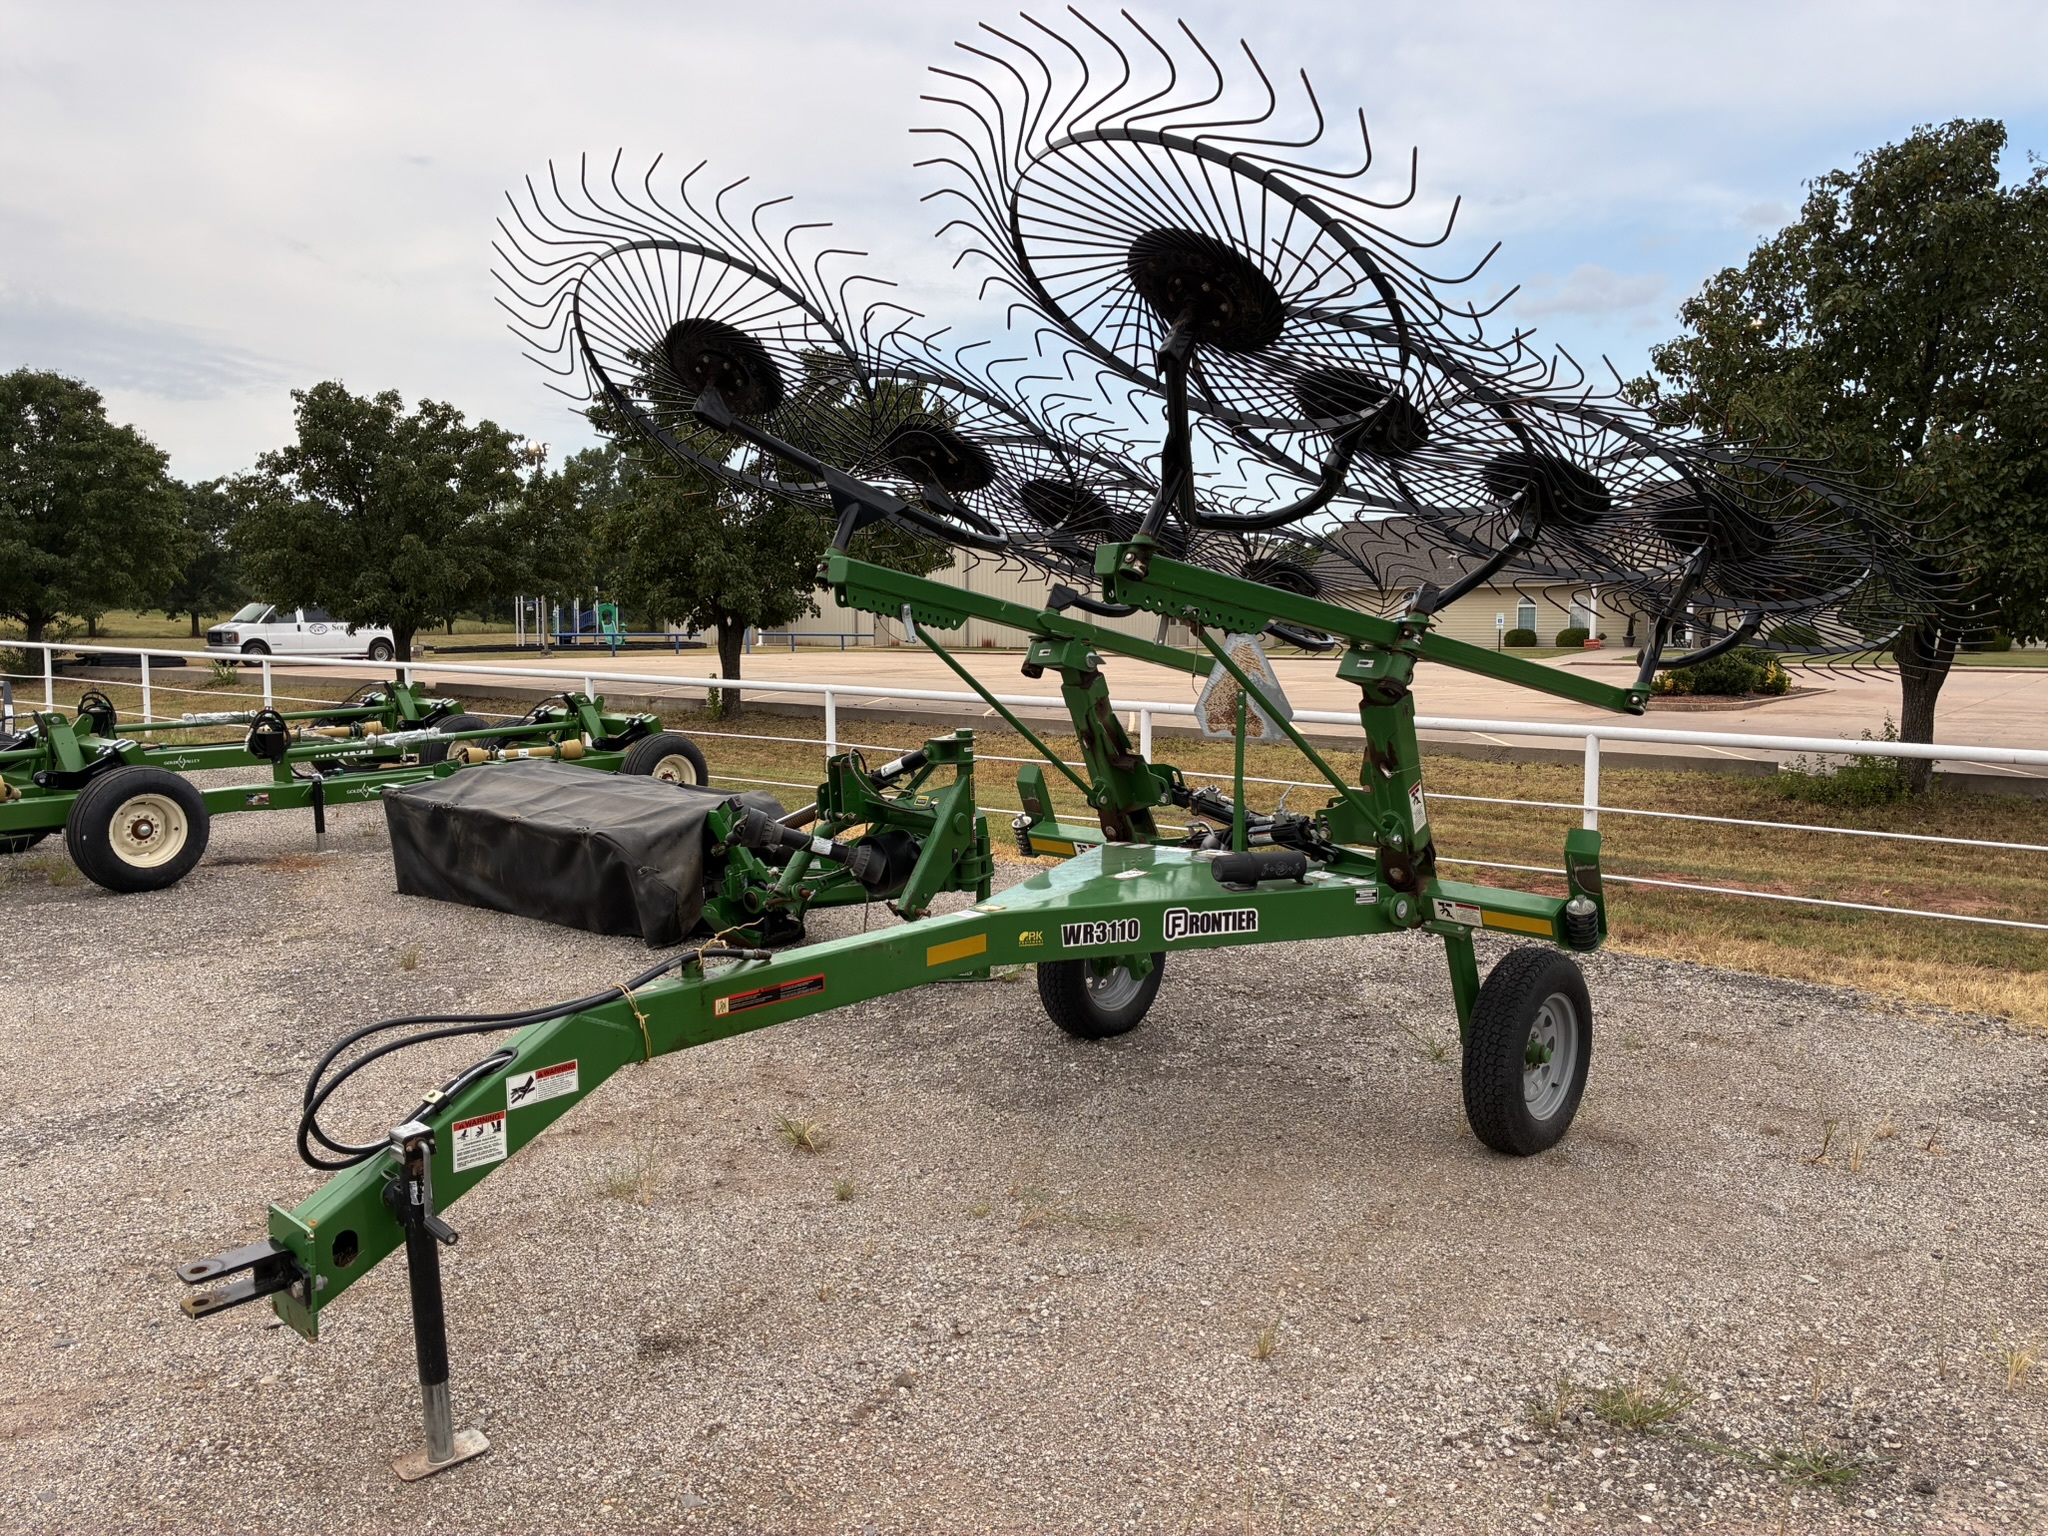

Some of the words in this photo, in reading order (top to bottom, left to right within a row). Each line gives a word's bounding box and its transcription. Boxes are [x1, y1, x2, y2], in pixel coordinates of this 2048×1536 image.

[1062, 919, 1139, 946] WR3110
[1165, 908, 1257, 939] FRONTIER
[543, 1062, 576, 1076] WARNING
[466, 1113, 500, 1127] WARNING
